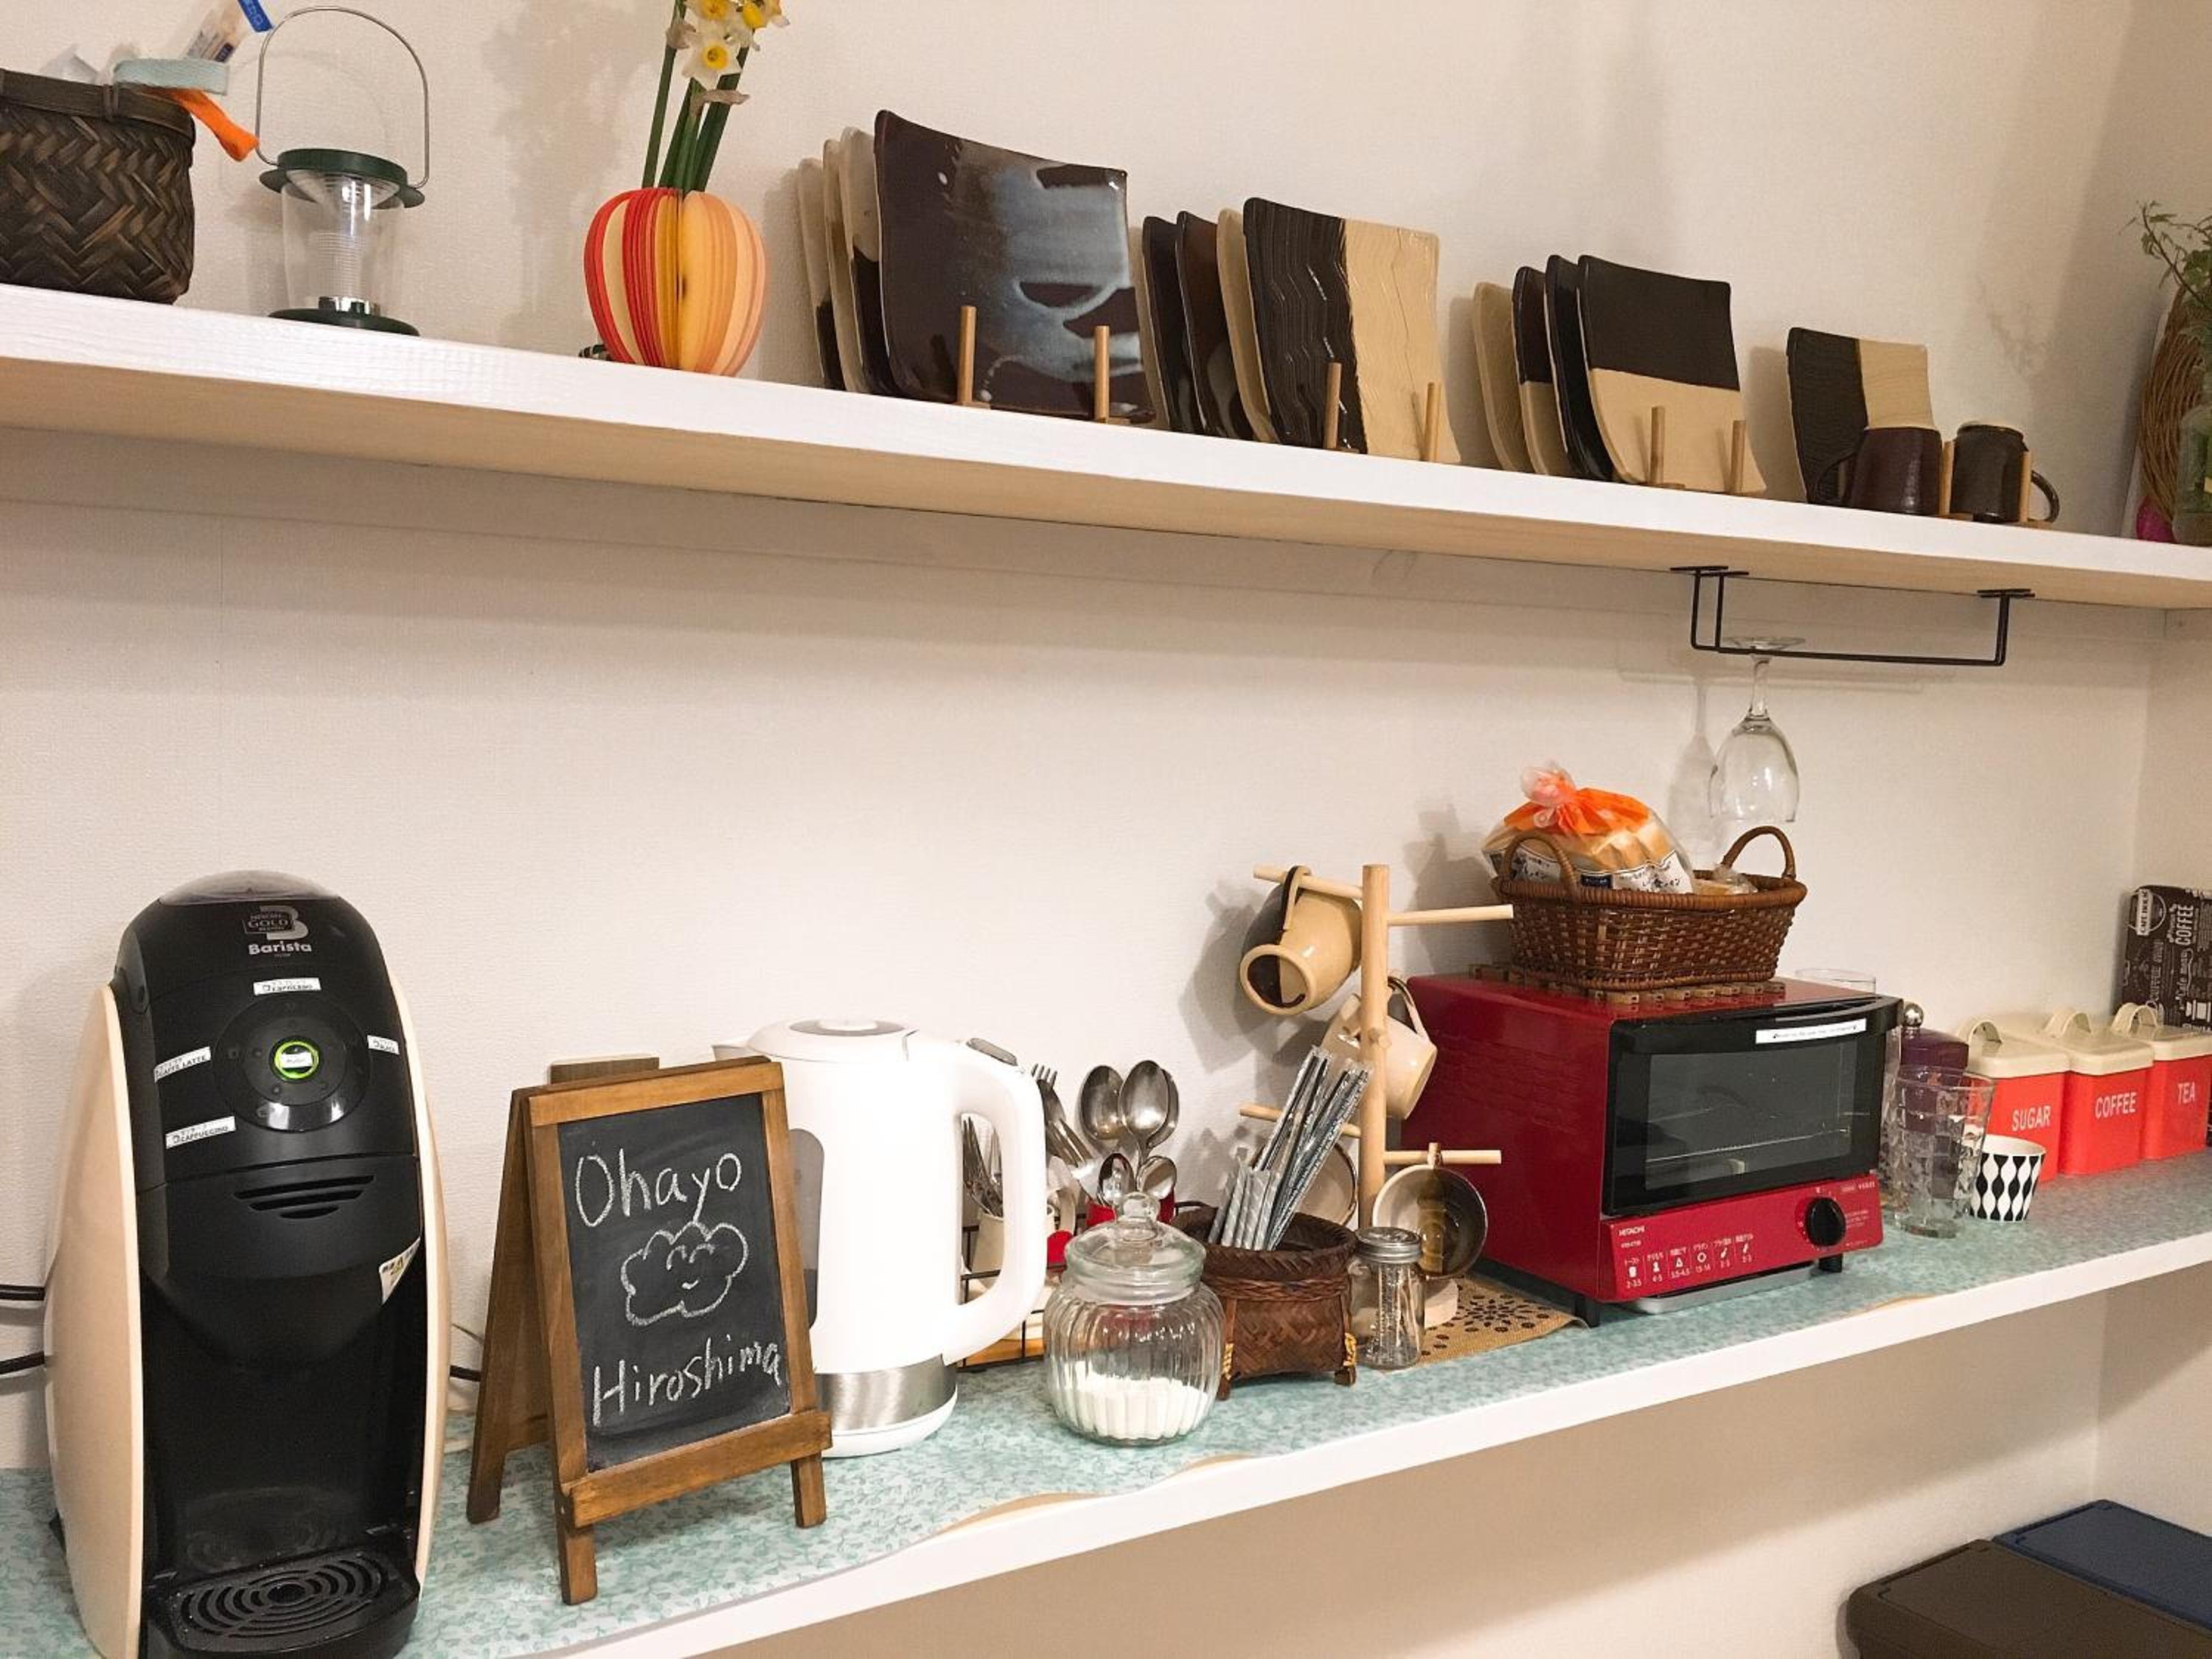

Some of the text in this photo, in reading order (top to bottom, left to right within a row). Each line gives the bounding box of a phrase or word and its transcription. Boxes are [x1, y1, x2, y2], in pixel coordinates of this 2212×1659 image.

[2175, 904, 2194, 946] COFFEE
[248, 940, 313, 956] Barista
[2095, 1092, 2138, 1119] COFFEE
[2177, 1082, 2196, 1104] TEA
[2011, 1105, 2051, 1132] SUGAR
[575, 1147, 742, 1227] Ohayo
[592, 1335, 783, 1427] Hiroshima
